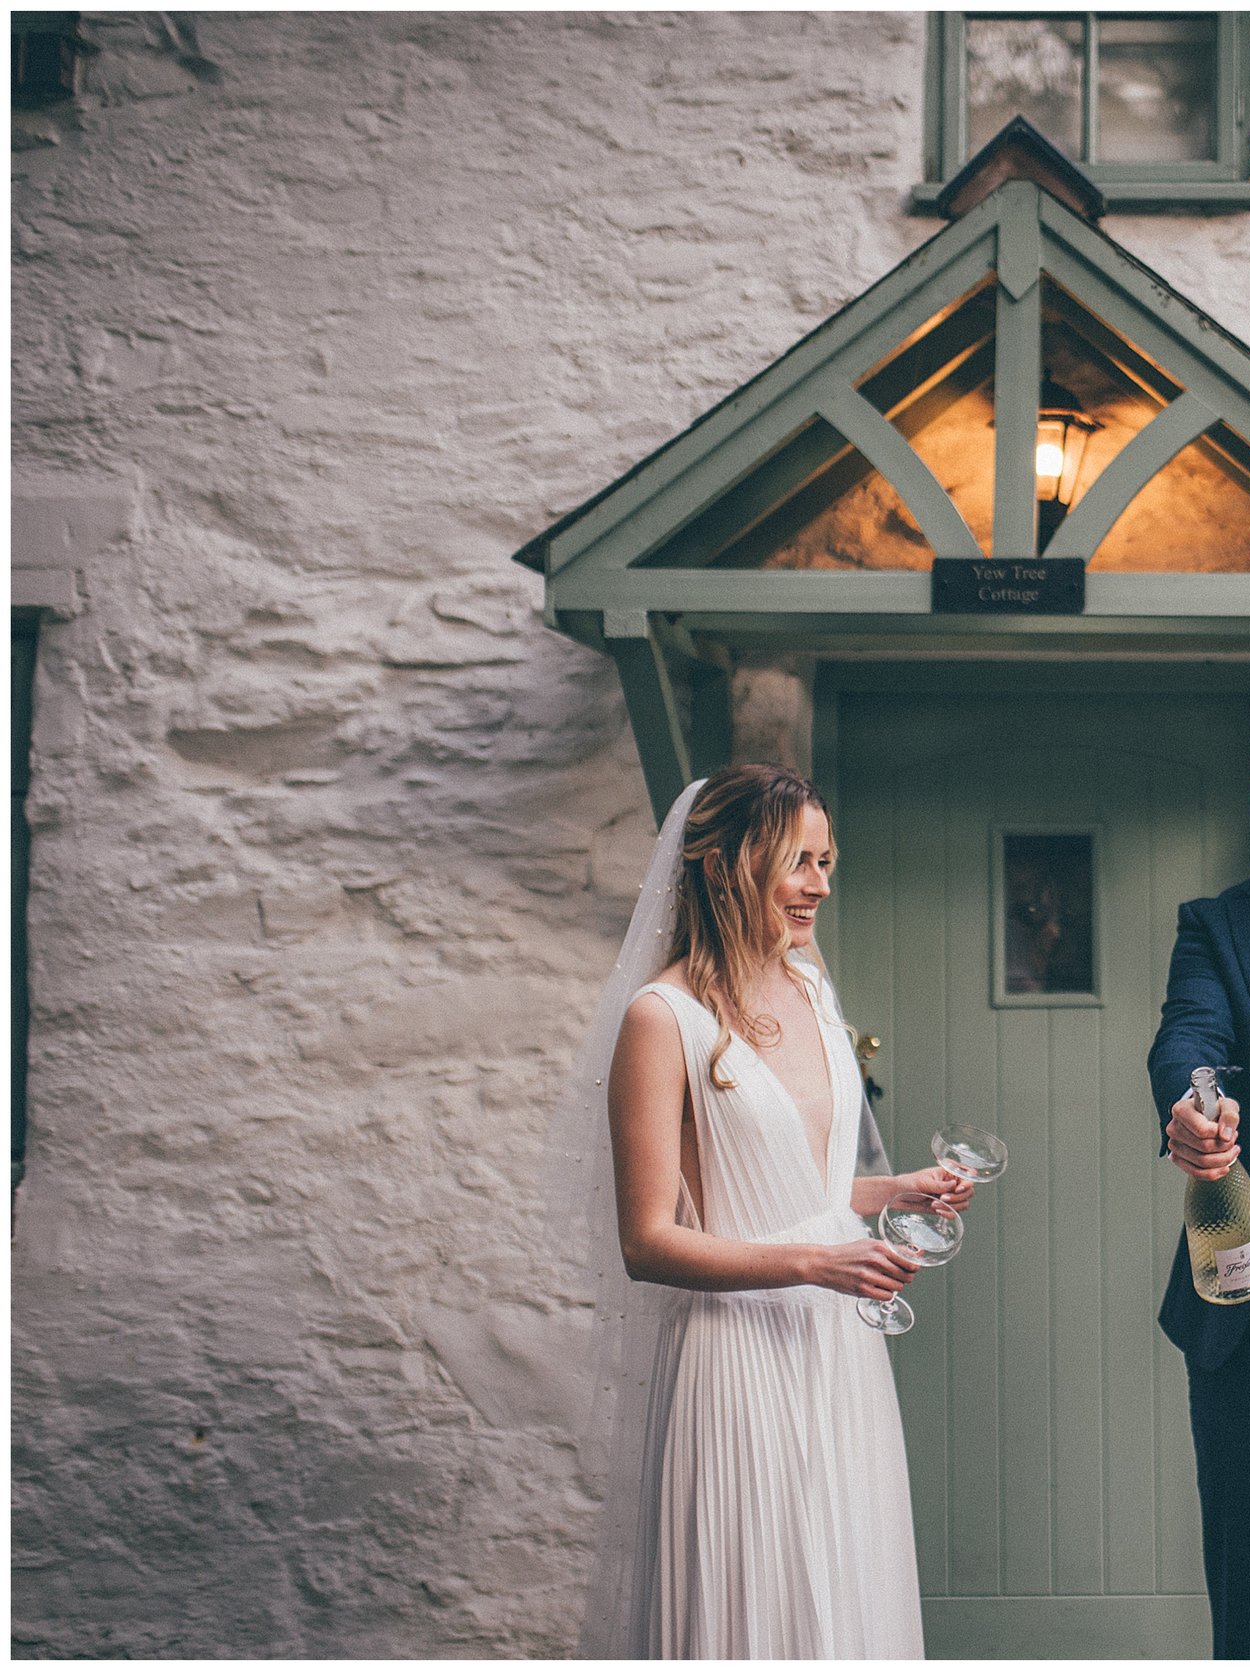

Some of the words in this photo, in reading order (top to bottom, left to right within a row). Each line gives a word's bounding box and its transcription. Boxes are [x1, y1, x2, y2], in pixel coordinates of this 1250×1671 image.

[972, 565, 1006, 580] Yew
[1011, 565, 1046, 580] Tree
[978, 586, 1040, 604] Cottage
